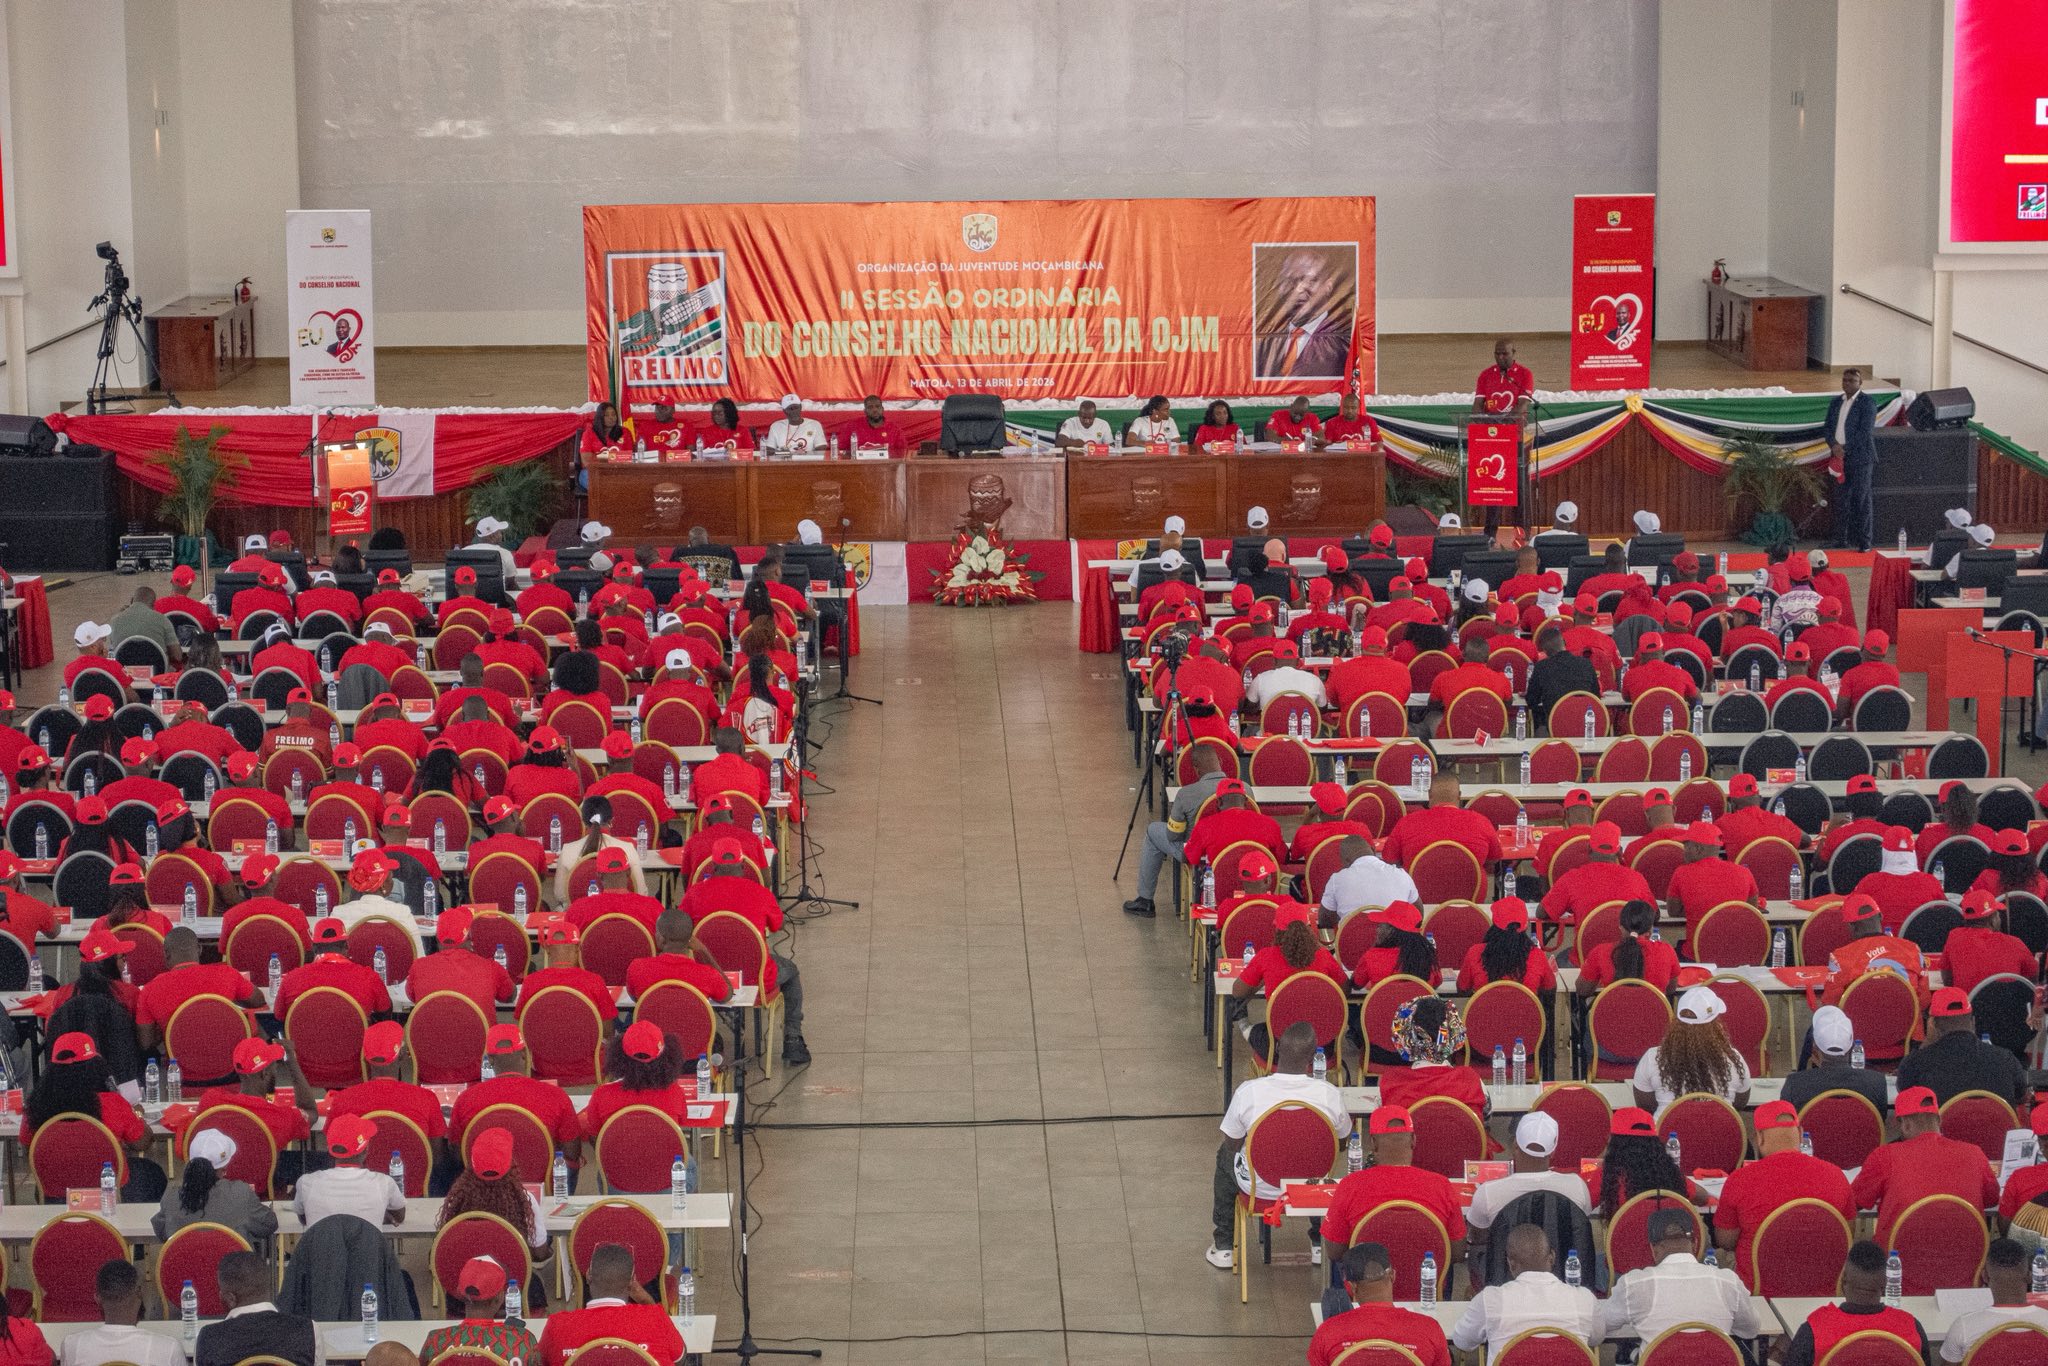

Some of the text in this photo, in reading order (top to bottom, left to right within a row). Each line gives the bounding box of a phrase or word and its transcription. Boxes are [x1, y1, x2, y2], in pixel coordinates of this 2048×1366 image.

[857, 260, 1104, 276] ORGANIZAÇÃO DA JUVENTUDE MOÇAMBICANA
[840, 279, 1121, 310] II SESSÃO ORDINÁRIA
[298, 327, 323, 348] EU
[743, 315, 1219, 358] DO CONSELHO NACIONAL DA OJM
[628, 356, 723, 381] RELIMO
[910, 377, 1055, 389] MATOLA, 13 DE ABRIL DE 2026
[653, 435, 665, 443] EU
[275, 735, 314, 746] FRELIMO
